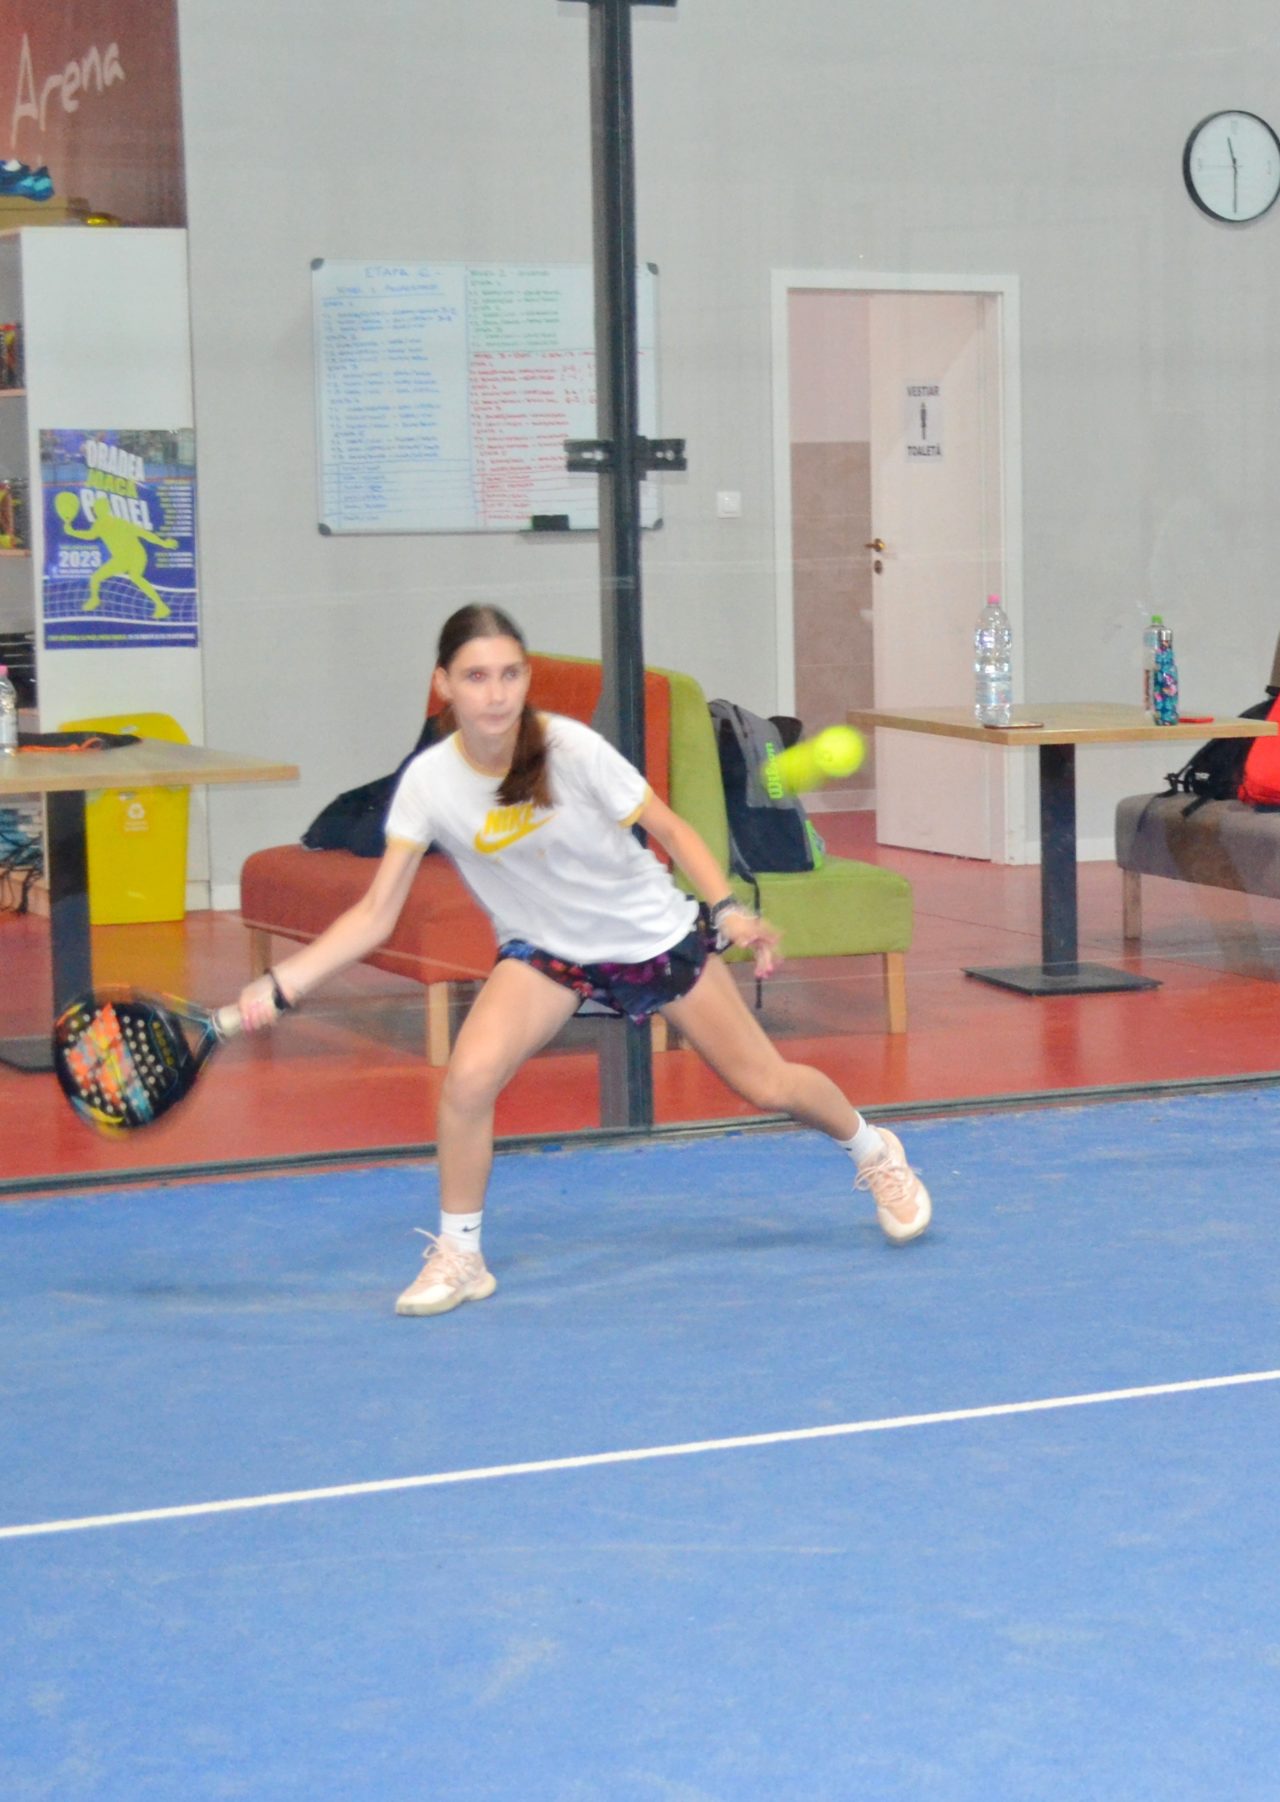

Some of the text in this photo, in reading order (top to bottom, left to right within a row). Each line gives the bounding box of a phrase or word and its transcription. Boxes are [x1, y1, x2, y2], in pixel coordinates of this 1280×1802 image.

[10, 33, 125, 147] Arena
[907, 386, 939, 396] VESTIAR
[85, 439, 145, 482] ORADEA
[58, 551, 101, 568] 2023
